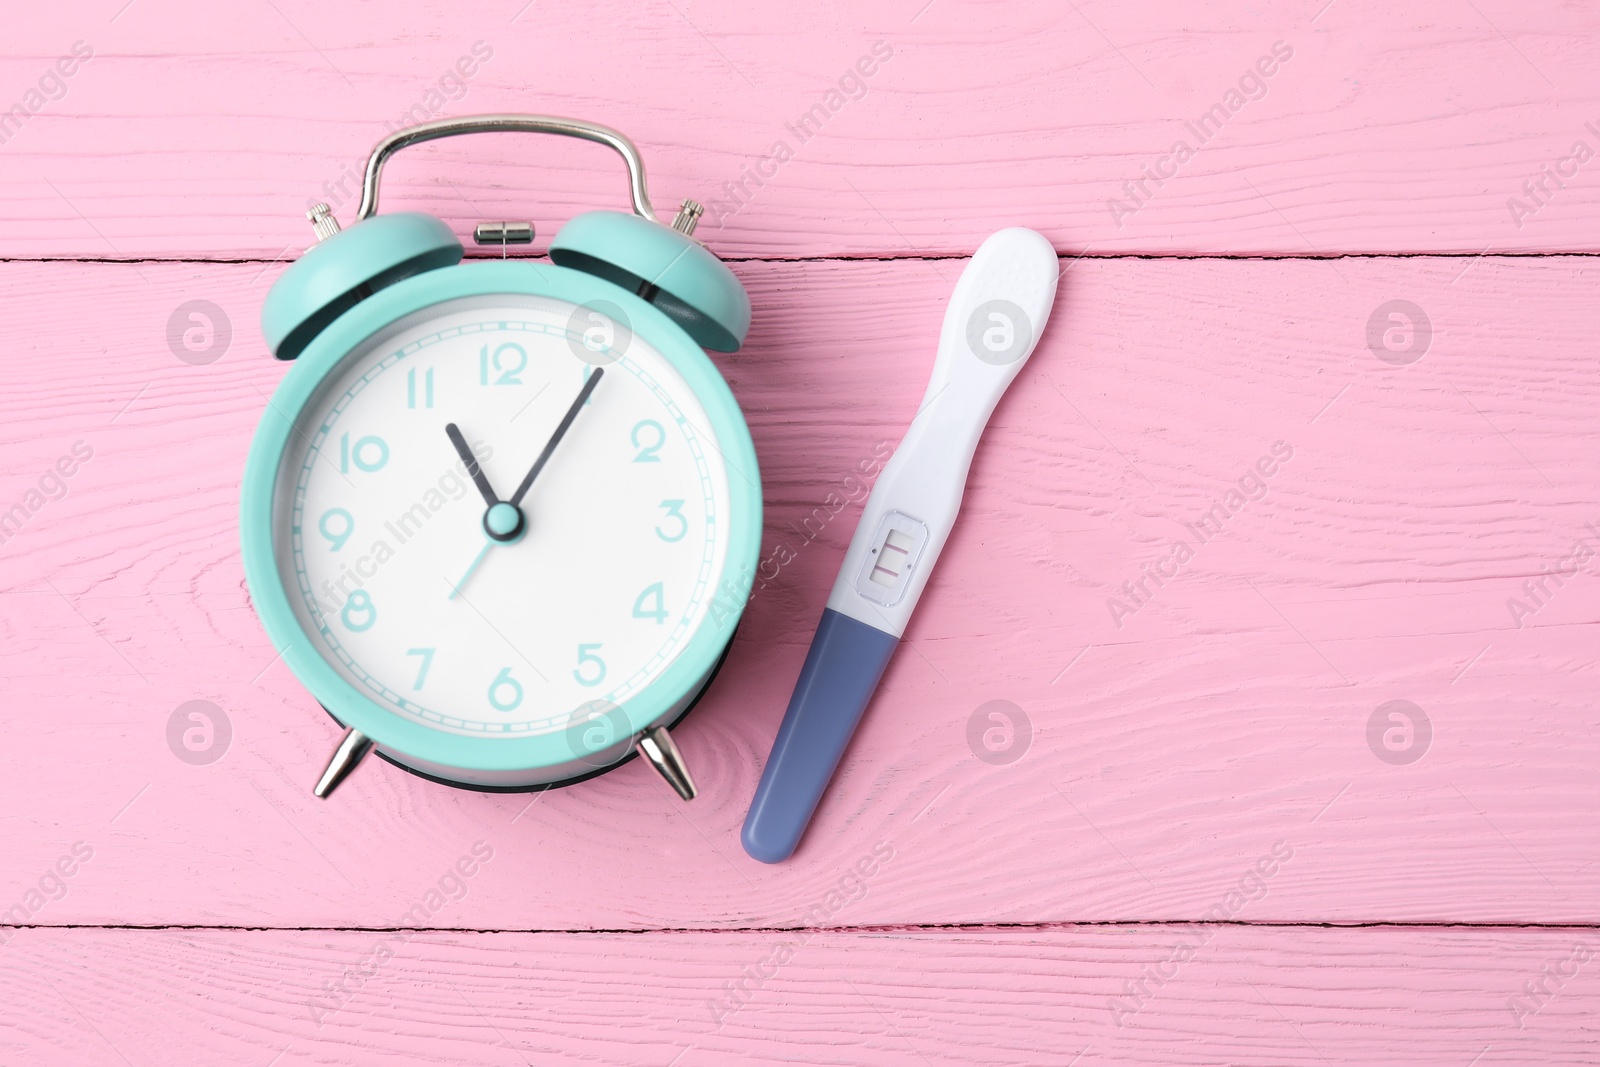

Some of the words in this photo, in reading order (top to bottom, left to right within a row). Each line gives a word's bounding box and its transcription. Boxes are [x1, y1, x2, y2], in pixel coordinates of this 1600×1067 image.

[479, 341, 529, 386] 12
[407, 367, 434, 409] 11
[340, 432, 390, 475] 10
[630, 419, 667, 463] 2
[318, 507, 355, 553] 9
[655, 499, 689, 543] 3
[340, 588, 377, 633] 8
[632, 581, 670, 625] 4
[407, 647, 436, 692] 7
[573, 642, 607, 688] 5
[487, 666, 525, 713] 6
